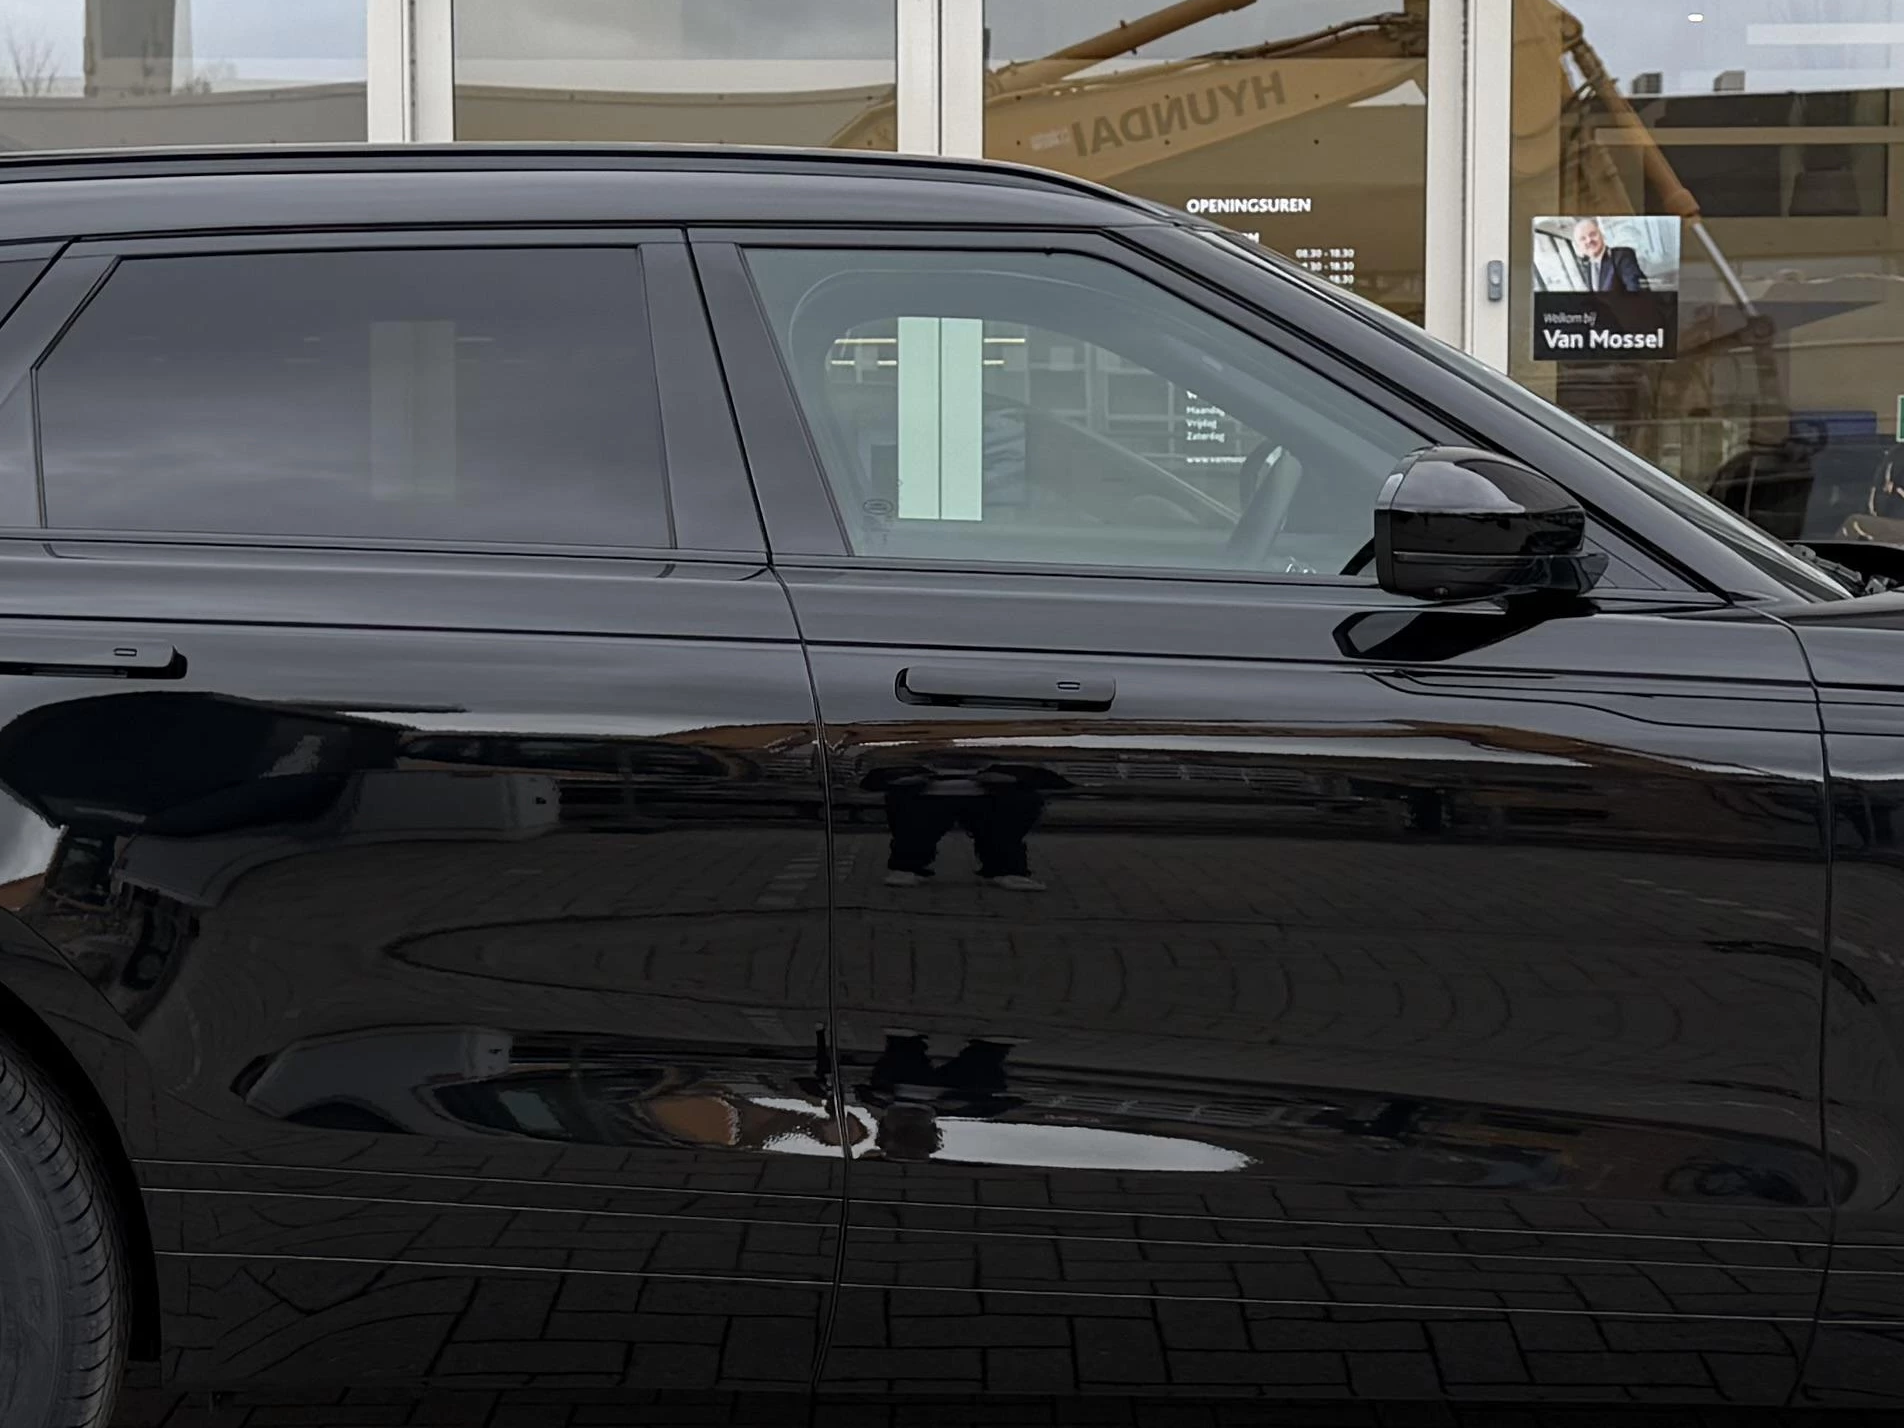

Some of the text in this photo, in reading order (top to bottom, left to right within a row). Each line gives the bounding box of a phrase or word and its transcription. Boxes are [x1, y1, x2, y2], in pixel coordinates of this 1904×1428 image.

[1186, 197, 1312, 214] OPENINGSUREN
[1543, 311, 1583, 324] Welkom
[1542, 327, 1665, 349] Van Mossel
